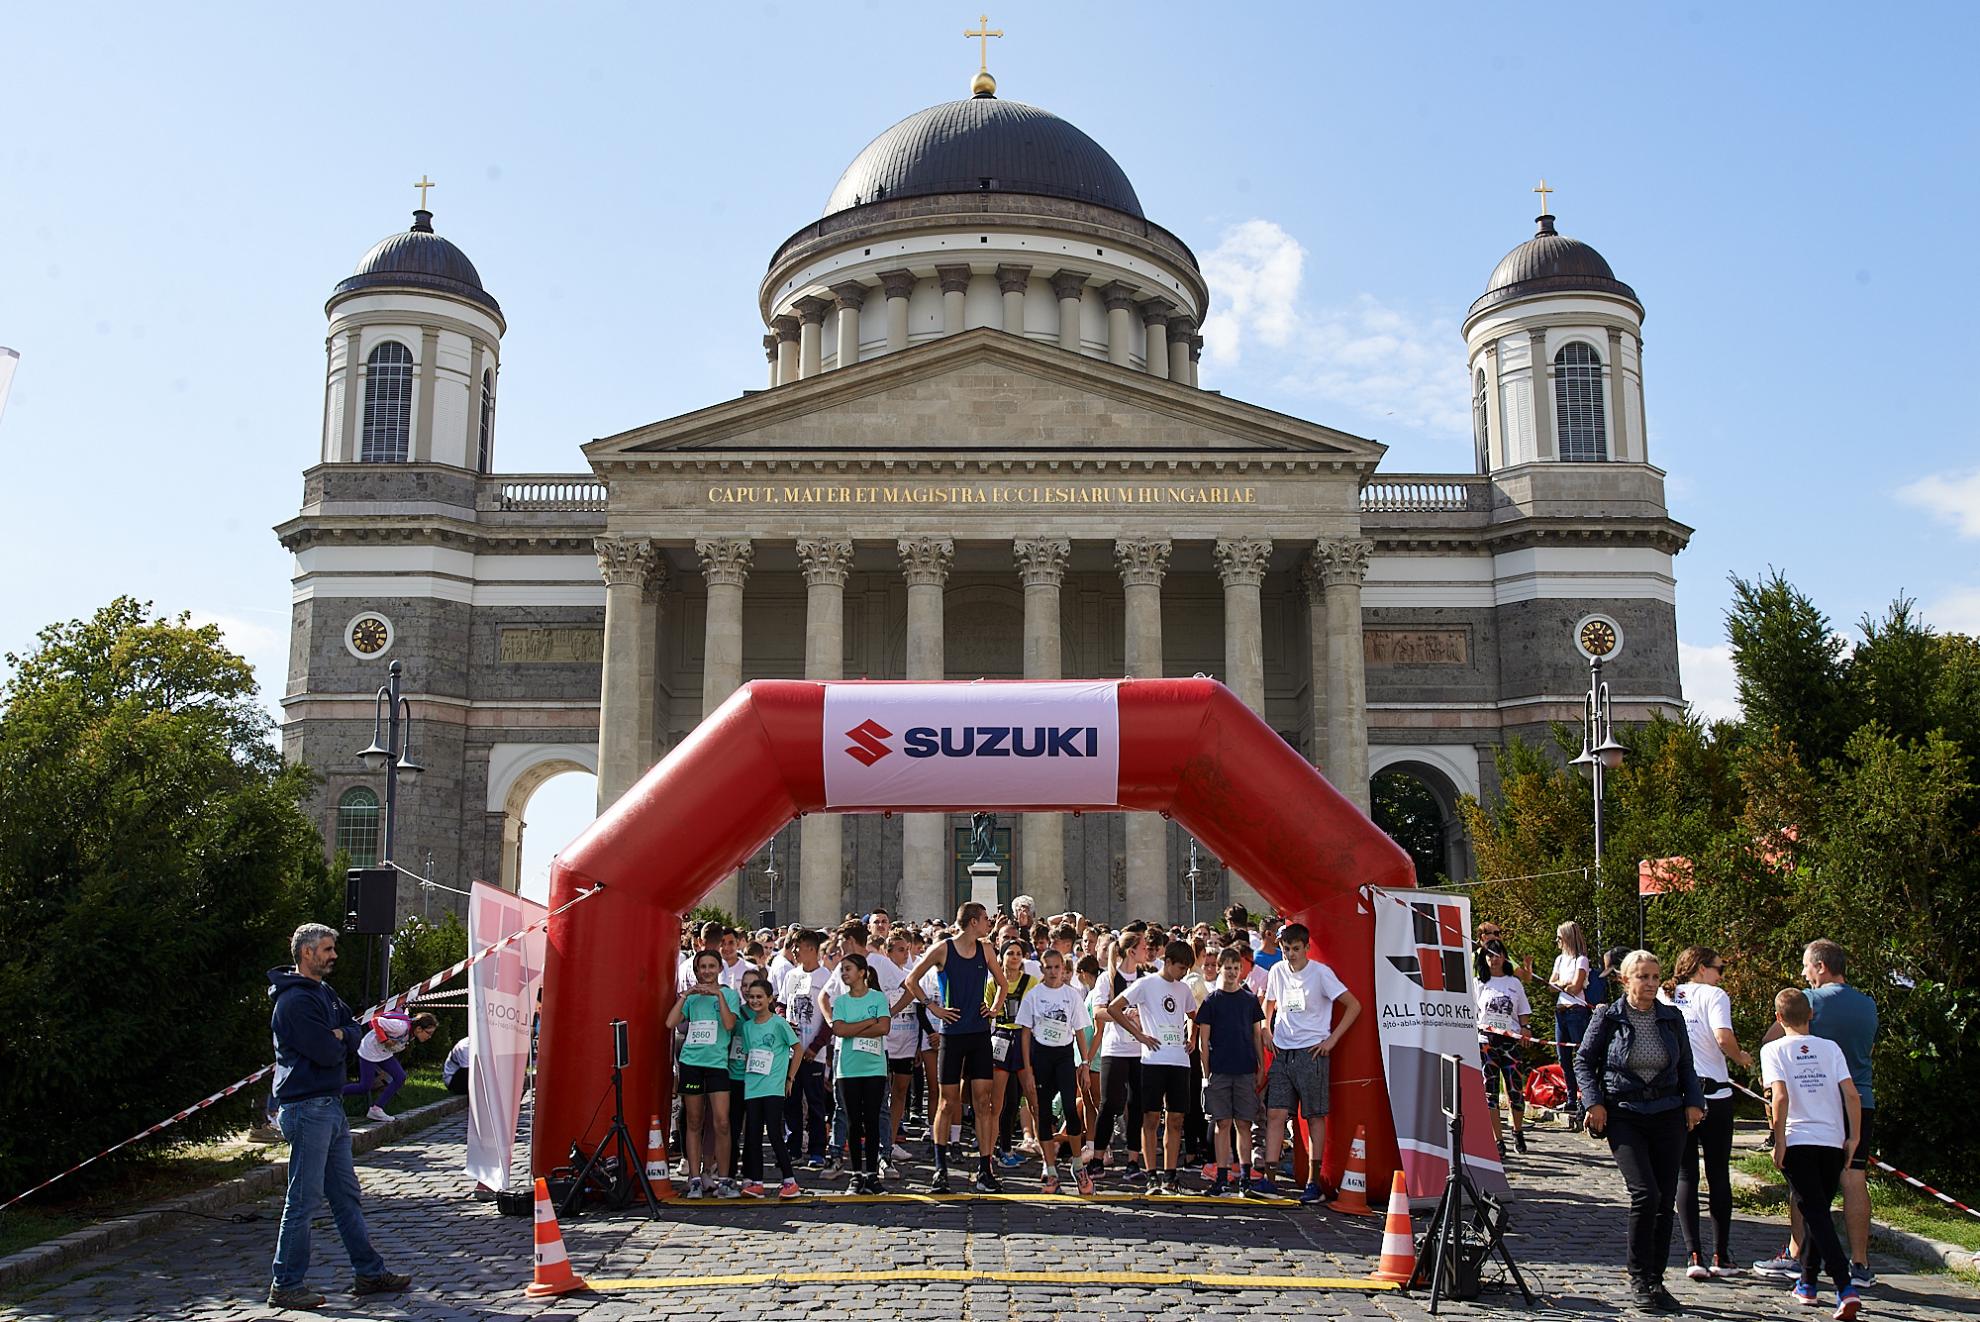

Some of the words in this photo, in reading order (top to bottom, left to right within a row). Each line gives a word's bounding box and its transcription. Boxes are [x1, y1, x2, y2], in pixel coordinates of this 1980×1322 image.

[708, 487, 778, 504] CAPUT,
[784, 487, 850, 503] MATER
[855, 487, 879, 503] ET
[882, 487, 987, 503] MAGISTRA
[993, 487, 1133, 503] ECCLESIARUM
[1139, 487, 1256, 503] HUNGARIAE
[903, 727, 1098, 758] SUZUKI
[1382, 1003, 1416, 1018] ALL
[1419, 1002, 1453, 1018] DOOR
[1455, 1004, 1474, 1020] Kft.
[692, 1031, 711, 1039] 5860
[1043, 1029, 1062, 1039] 5521
[1163, 1033, 1181, 1042] 5815
